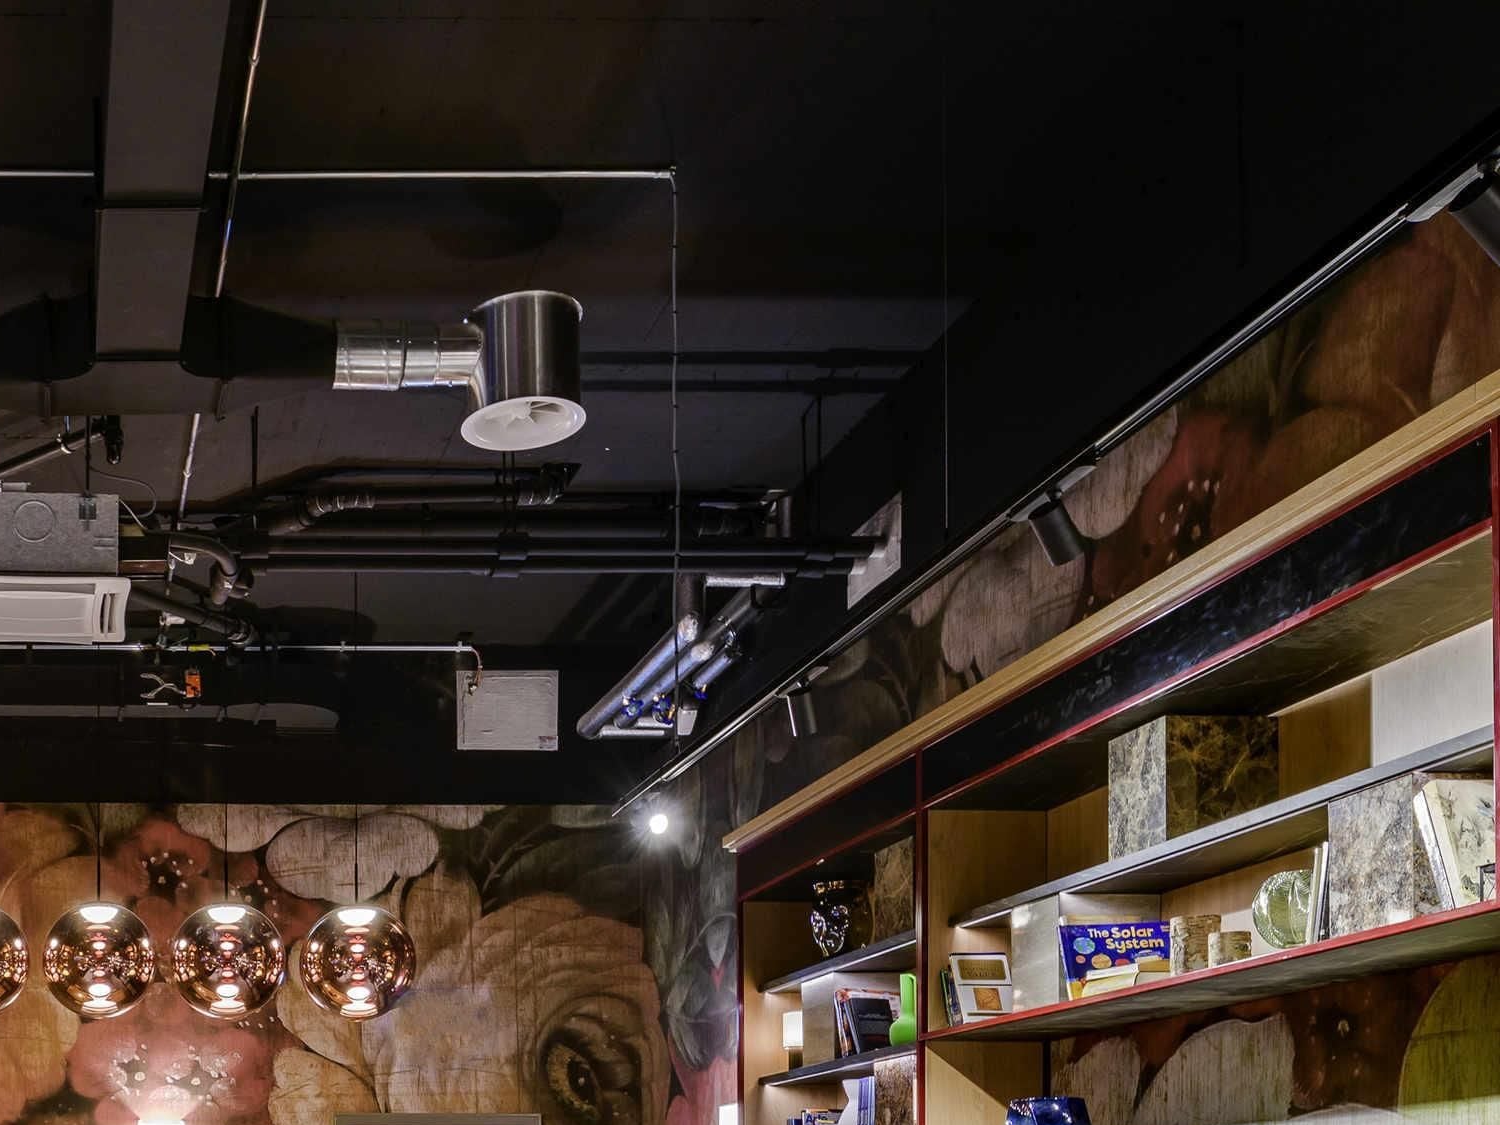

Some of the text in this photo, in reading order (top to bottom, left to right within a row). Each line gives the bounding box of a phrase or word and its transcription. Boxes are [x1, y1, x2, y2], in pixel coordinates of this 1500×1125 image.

[1087, 928, 1109, 939] The
[1110, 926, 1154, 939] Solar
[1105, 938, 1164, 953] System
